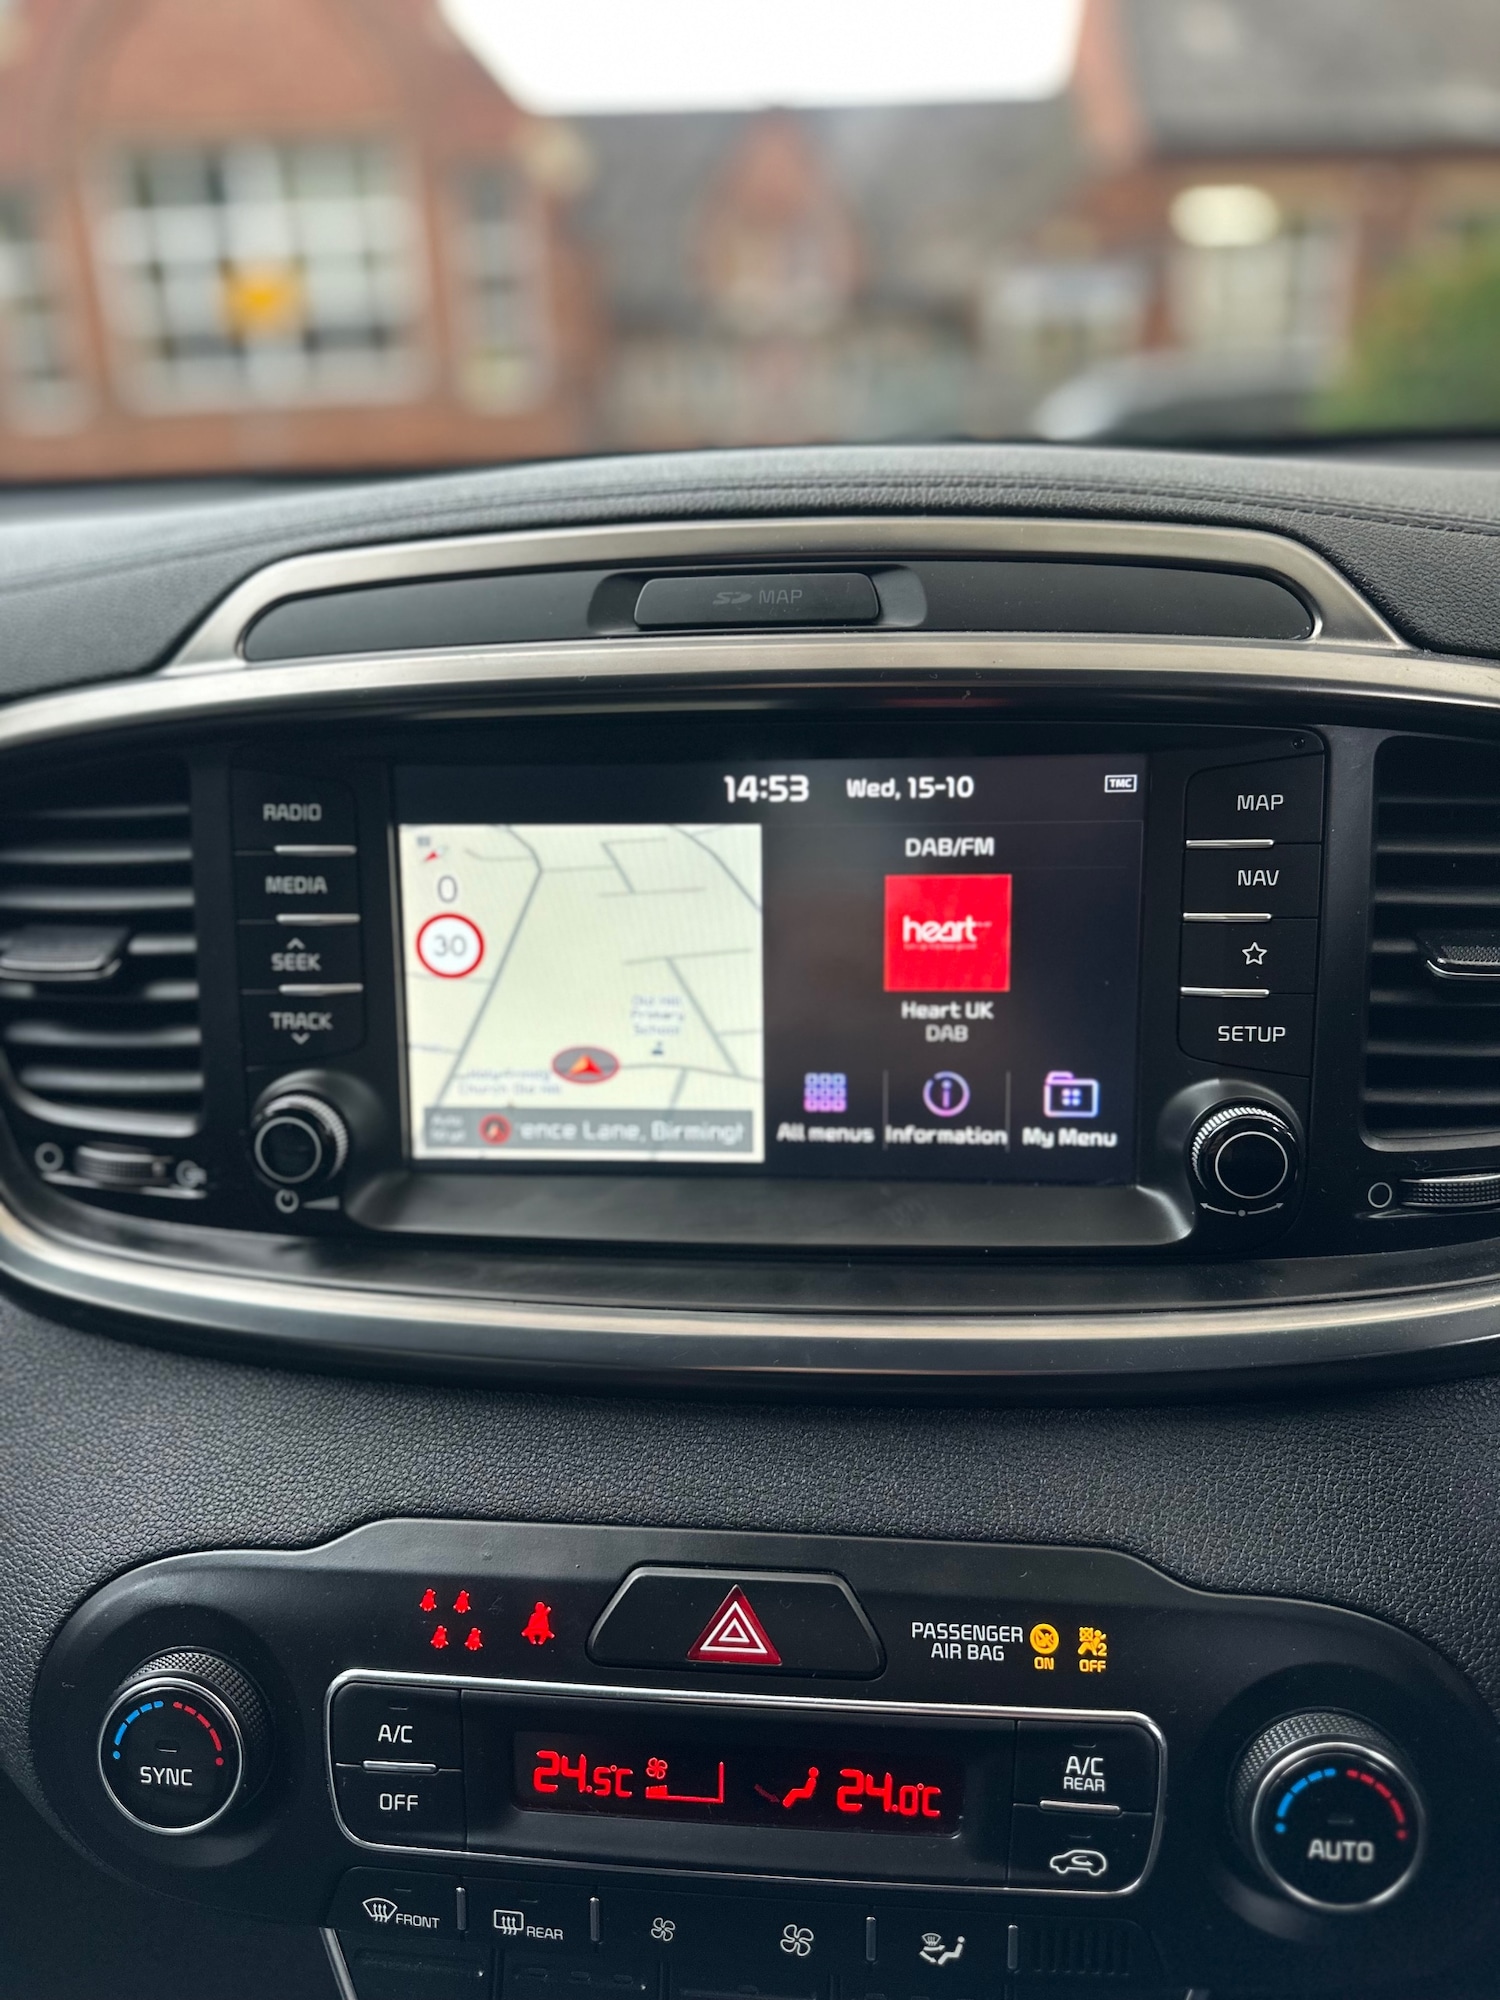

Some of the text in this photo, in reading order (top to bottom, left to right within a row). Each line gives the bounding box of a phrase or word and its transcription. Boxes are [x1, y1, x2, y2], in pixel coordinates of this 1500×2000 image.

[759, 588, 803, 605] MAP
[723, 774, 810, 803] 14:53
[846, 775, 975, 801] Wed, 15-10
[1109, 778, 1133, 789] TMC
[262, 803, 323, 821] RADIO
[1236, 794, 1284, 811] MAP
[904, 836, 995, 858] DAB/FM
[265, 876, 328, 894] MEDIA
[1237, 869, 1279, 886] NAV
[437, 874, 459, 904] 0
[902, 914, 978, 944] heart
[432, 933, 468, 958] 30
[270, 952, 322, 972] SEEK
[901, 1000, 995, 1020] Heart UK
[269, 1012, 333, 1031] TRACK
[924, 1023, 969, 1042] DAB
[1217, 1025, 1286, 1043] SETUP
[515, 1122, 578, 1141] ence
[582, 1119, 648, 1143] Lane,
[777, 1121, 875, 1143] All menus
[885, 1124, 1008, 1145] Information
[1021, 1126, 1118, 1148] My Menu
[911, 1621, 1024, 1644] PASSENGER
[930, 1643, 1005, 1662] AIR BAG
[1034, 1656, 1055, 1671] ON
[1079, 1659, 1106, 1673] OFF
[377, 1724, 413, 1744] A/C
[140, 1765, 194, 1786] SYNC
[1065, 1755, 1104, 1777] A/C
[1063, 1776, 1106, 1793] REAR
[378, 1793, 419, 1811] OFF
[1307, 1838, 1375, 1863] AUTO
[395, 1913, 441, 1930] FRONT
[526, 1925, 565, 1941] REAR
